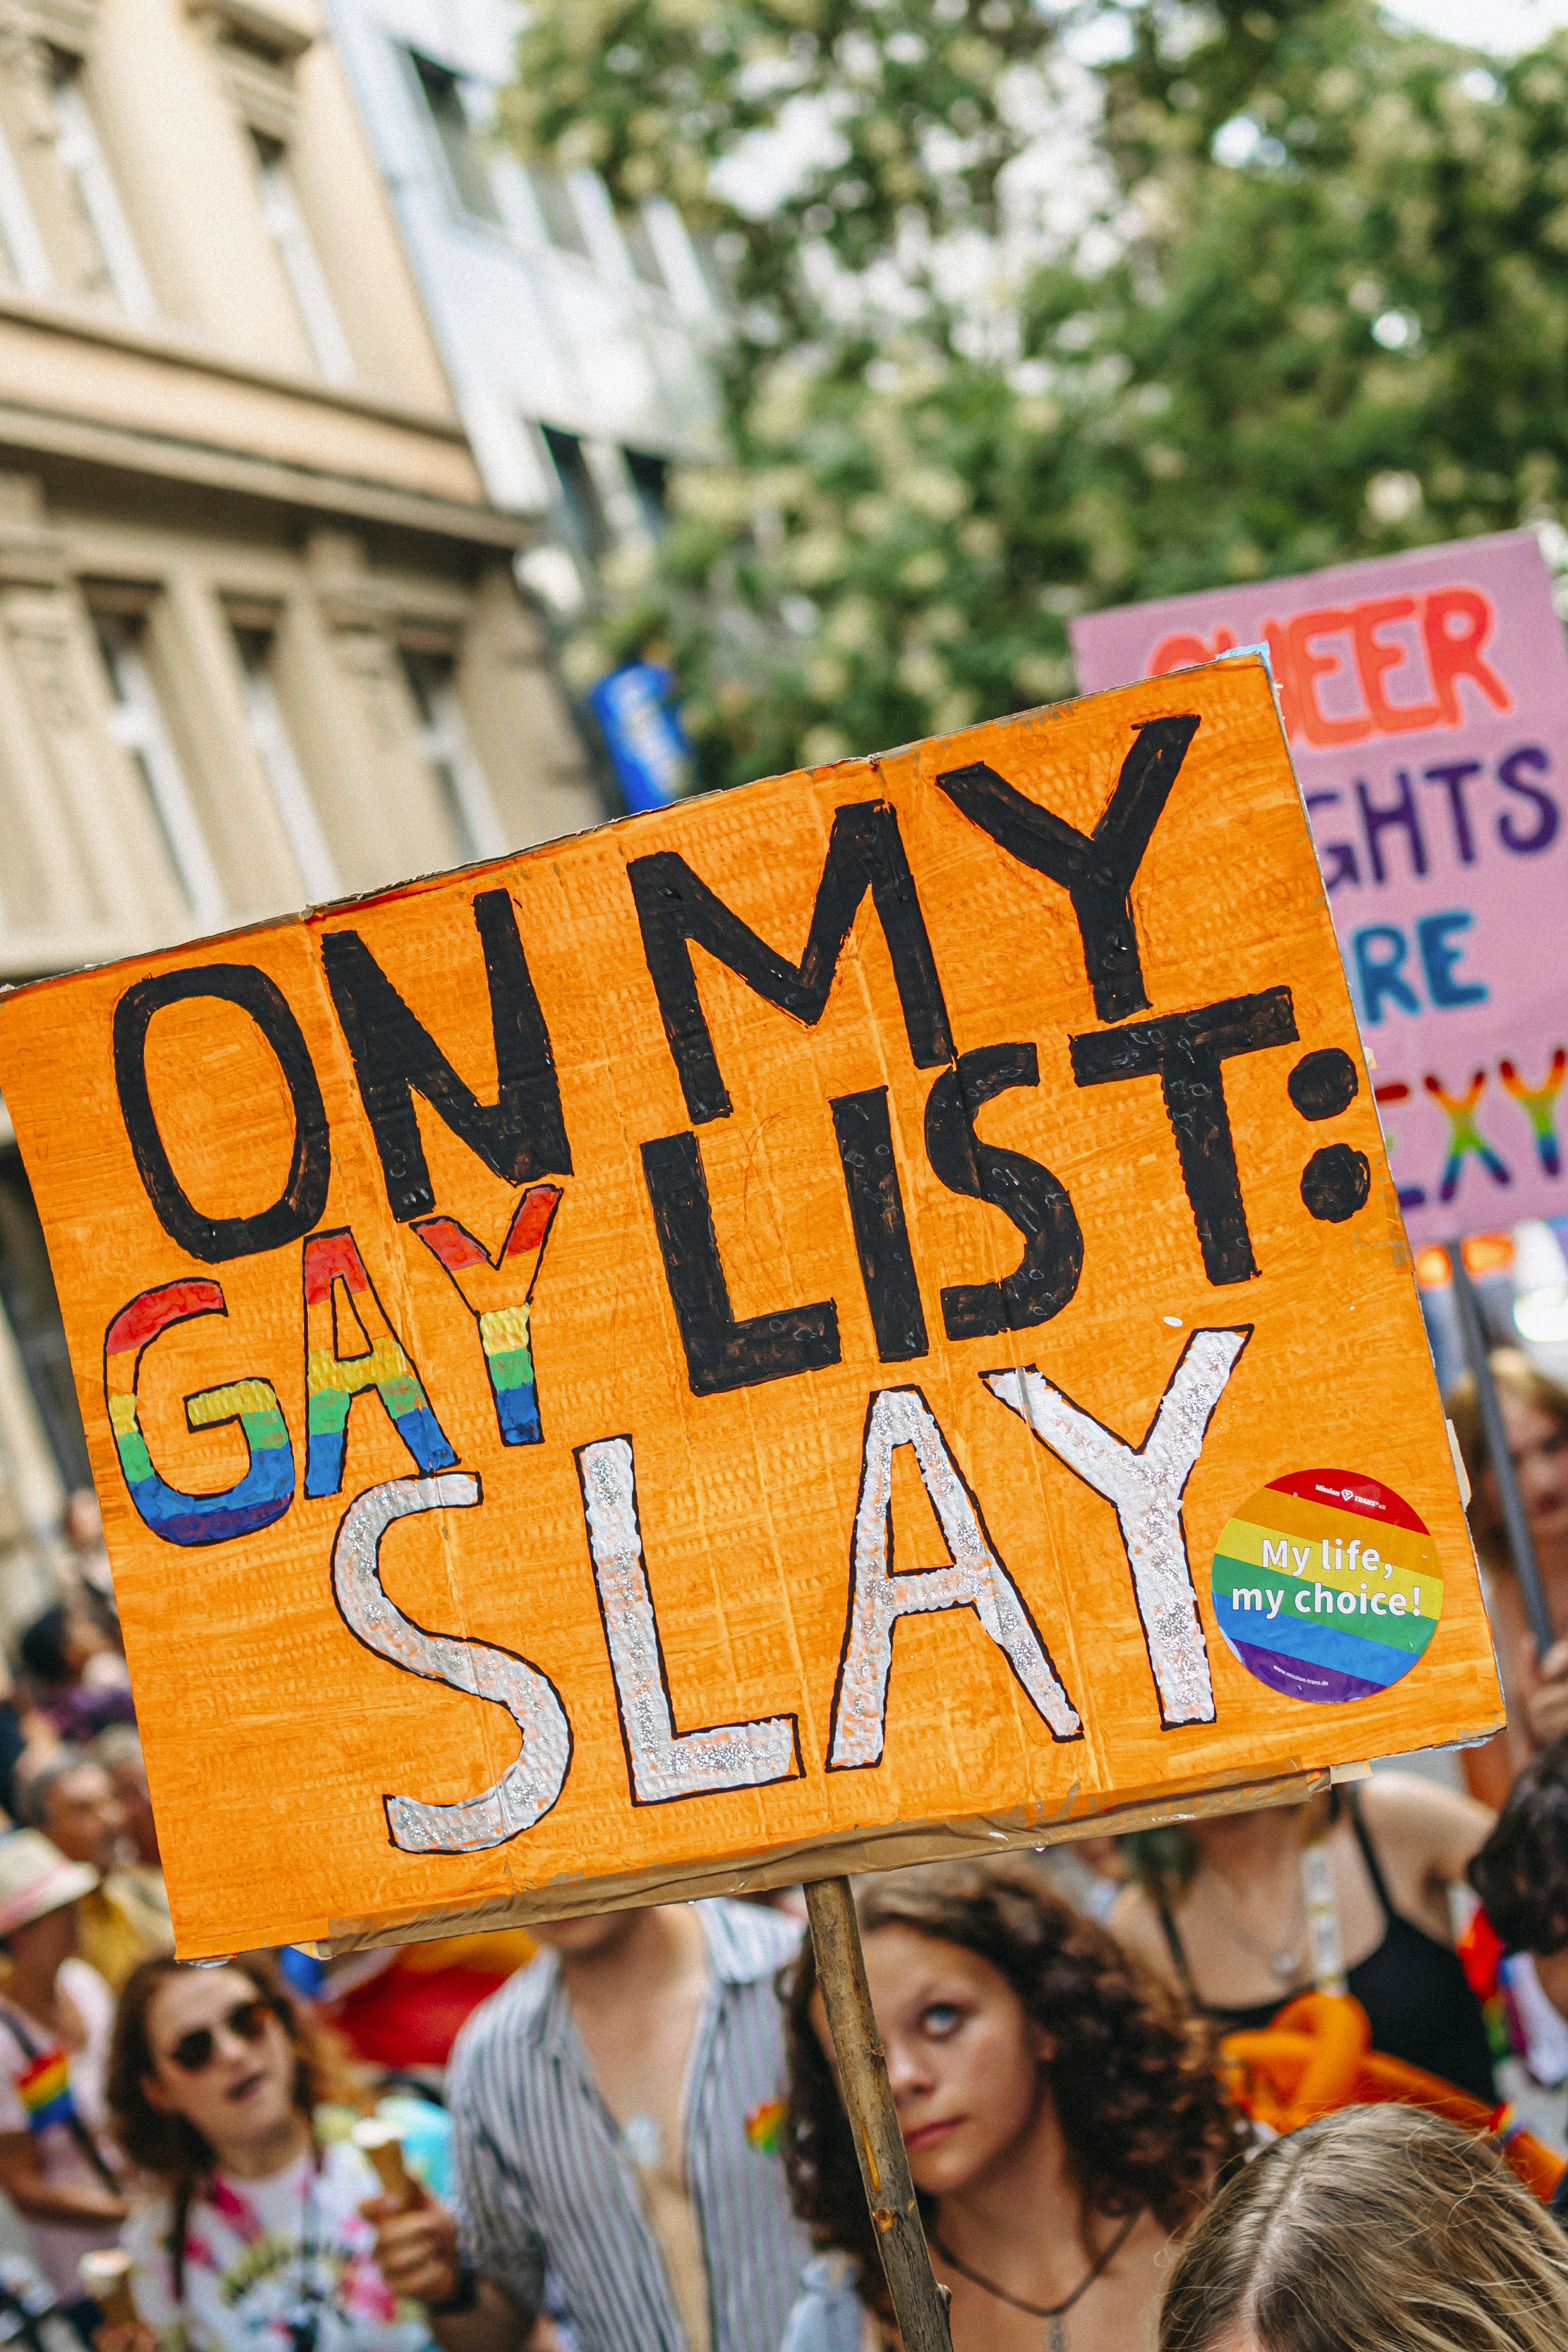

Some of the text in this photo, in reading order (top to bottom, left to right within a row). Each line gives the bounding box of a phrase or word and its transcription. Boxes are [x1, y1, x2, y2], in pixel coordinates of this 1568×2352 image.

[1305, 743, 1560, 893] GHTS
[114, 715, 1200, 1263] ON MY
[1353, 909, 1489, 1024] RE
[103, 985, 1371, 1546] GAY LIST:
[1315, 1484, 1340, 1496] Mission
[331, 1324, 1254, 1855] SLAY
[1232, 1582, 1422, 1619] my choice!
[1261, 1538, 1394, 1579] My life,
[1273, 1664, 1329, 1686] www.mission-trans.de
